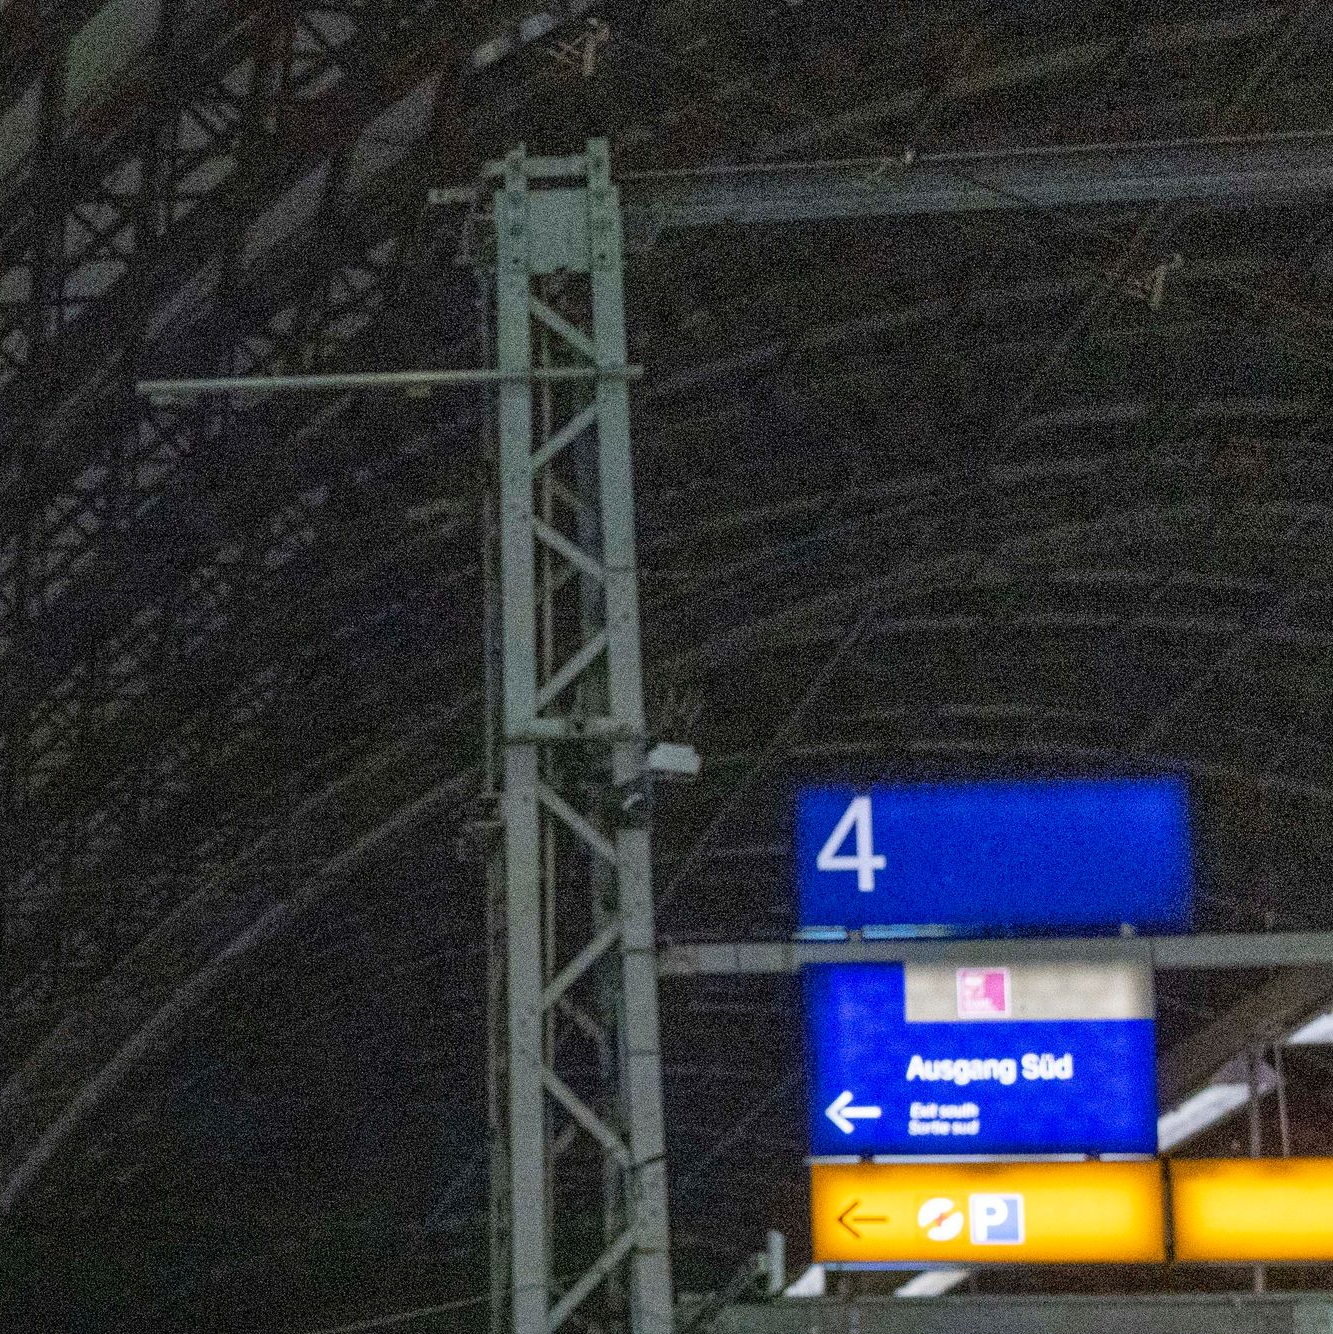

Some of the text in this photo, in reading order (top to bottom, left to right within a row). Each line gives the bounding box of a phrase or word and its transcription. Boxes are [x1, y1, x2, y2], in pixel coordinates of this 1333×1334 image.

[815, 796, 888, 893] 4
[905, 1051, 1074, 1086] Ausgang Süd
[974, 1200, 1009, 1239] P
